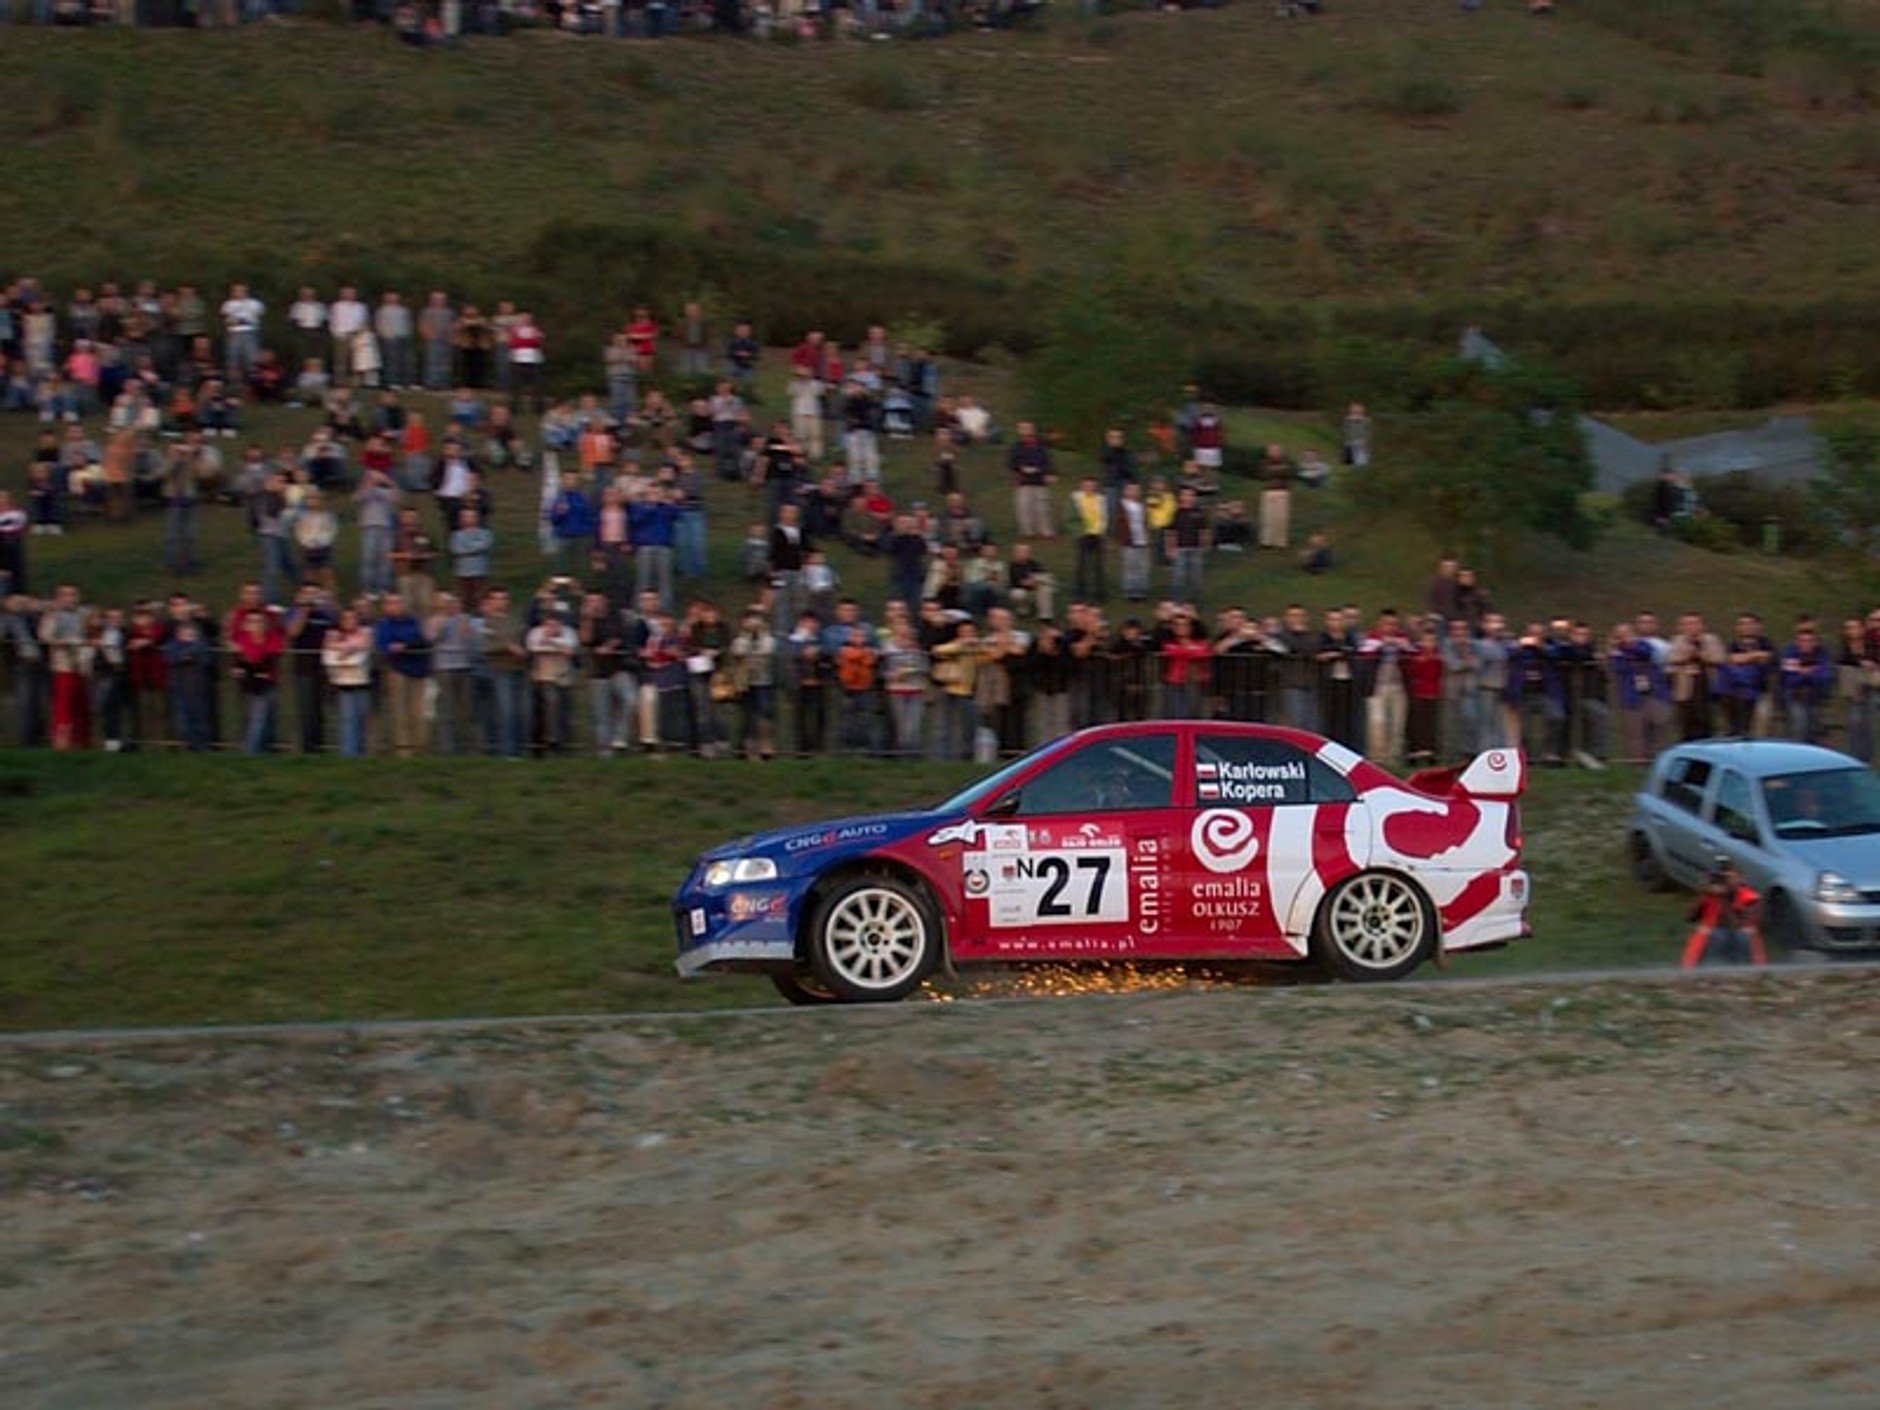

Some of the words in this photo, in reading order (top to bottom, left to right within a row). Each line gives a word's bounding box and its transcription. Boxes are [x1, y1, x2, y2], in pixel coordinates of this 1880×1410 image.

[1221, 780, 1285, 802] Kopera
[838, 824, 888, 839] AUTO
[1016, 857, 1033, 879] N
[1036, 856, 1111, 917] 27
[1130, 839, 1160, 934] emalia
[1192, 876, 1261, 899] emalia
[1192, 901, 1261, 918] OLKUSZ
